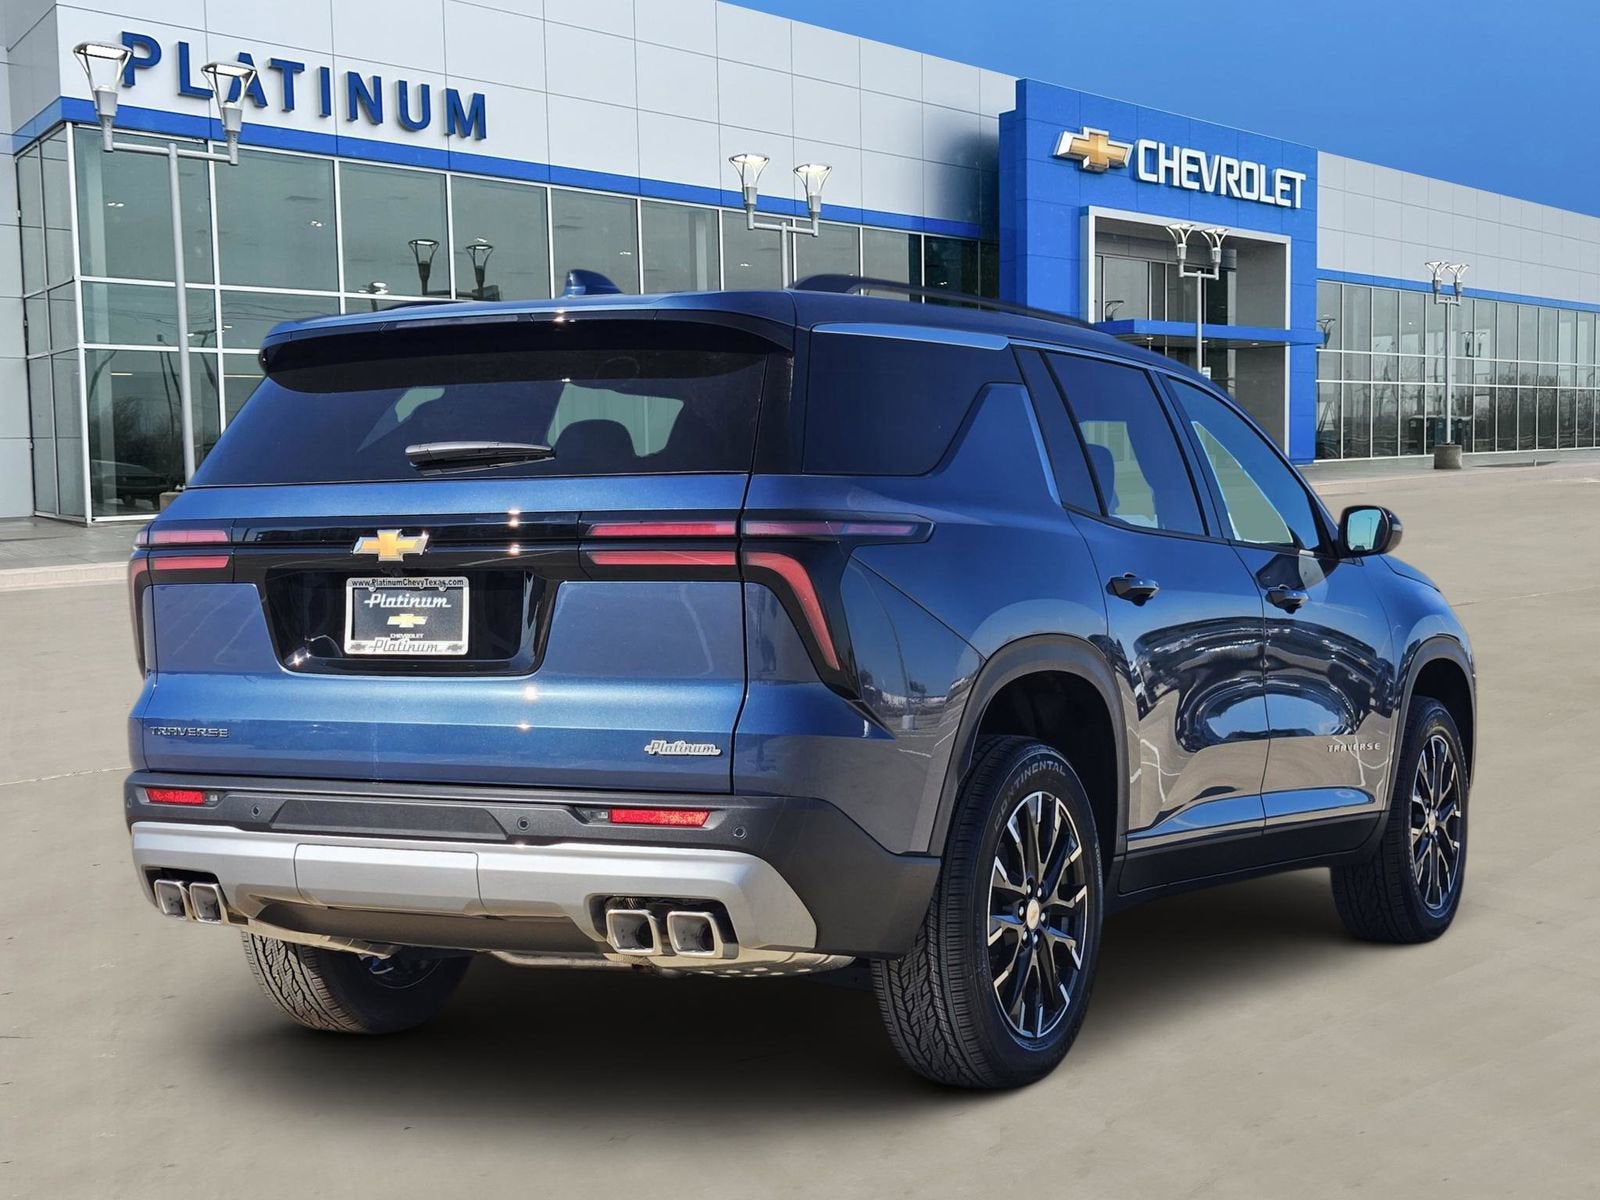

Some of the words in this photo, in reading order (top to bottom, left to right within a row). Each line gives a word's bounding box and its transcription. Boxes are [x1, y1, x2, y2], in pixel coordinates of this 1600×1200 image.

[121, 31, 487, 140] PLATINUM
[1136, 139, 1306, 209] CHEVROLET
[351, 578, 464, 588] www.PlatinumChevyTexas.com
[363, 593, 452, 608] Platinum
[369, 639, 439, 652] Platinum
[150, 727, 229, 737] TRAVERSE
[644, 740, 721, 756] Platinum
[1327, 743, 1381, 753] TRAVERSE
[994, 760, 1067, 832] CONTINENTAL
